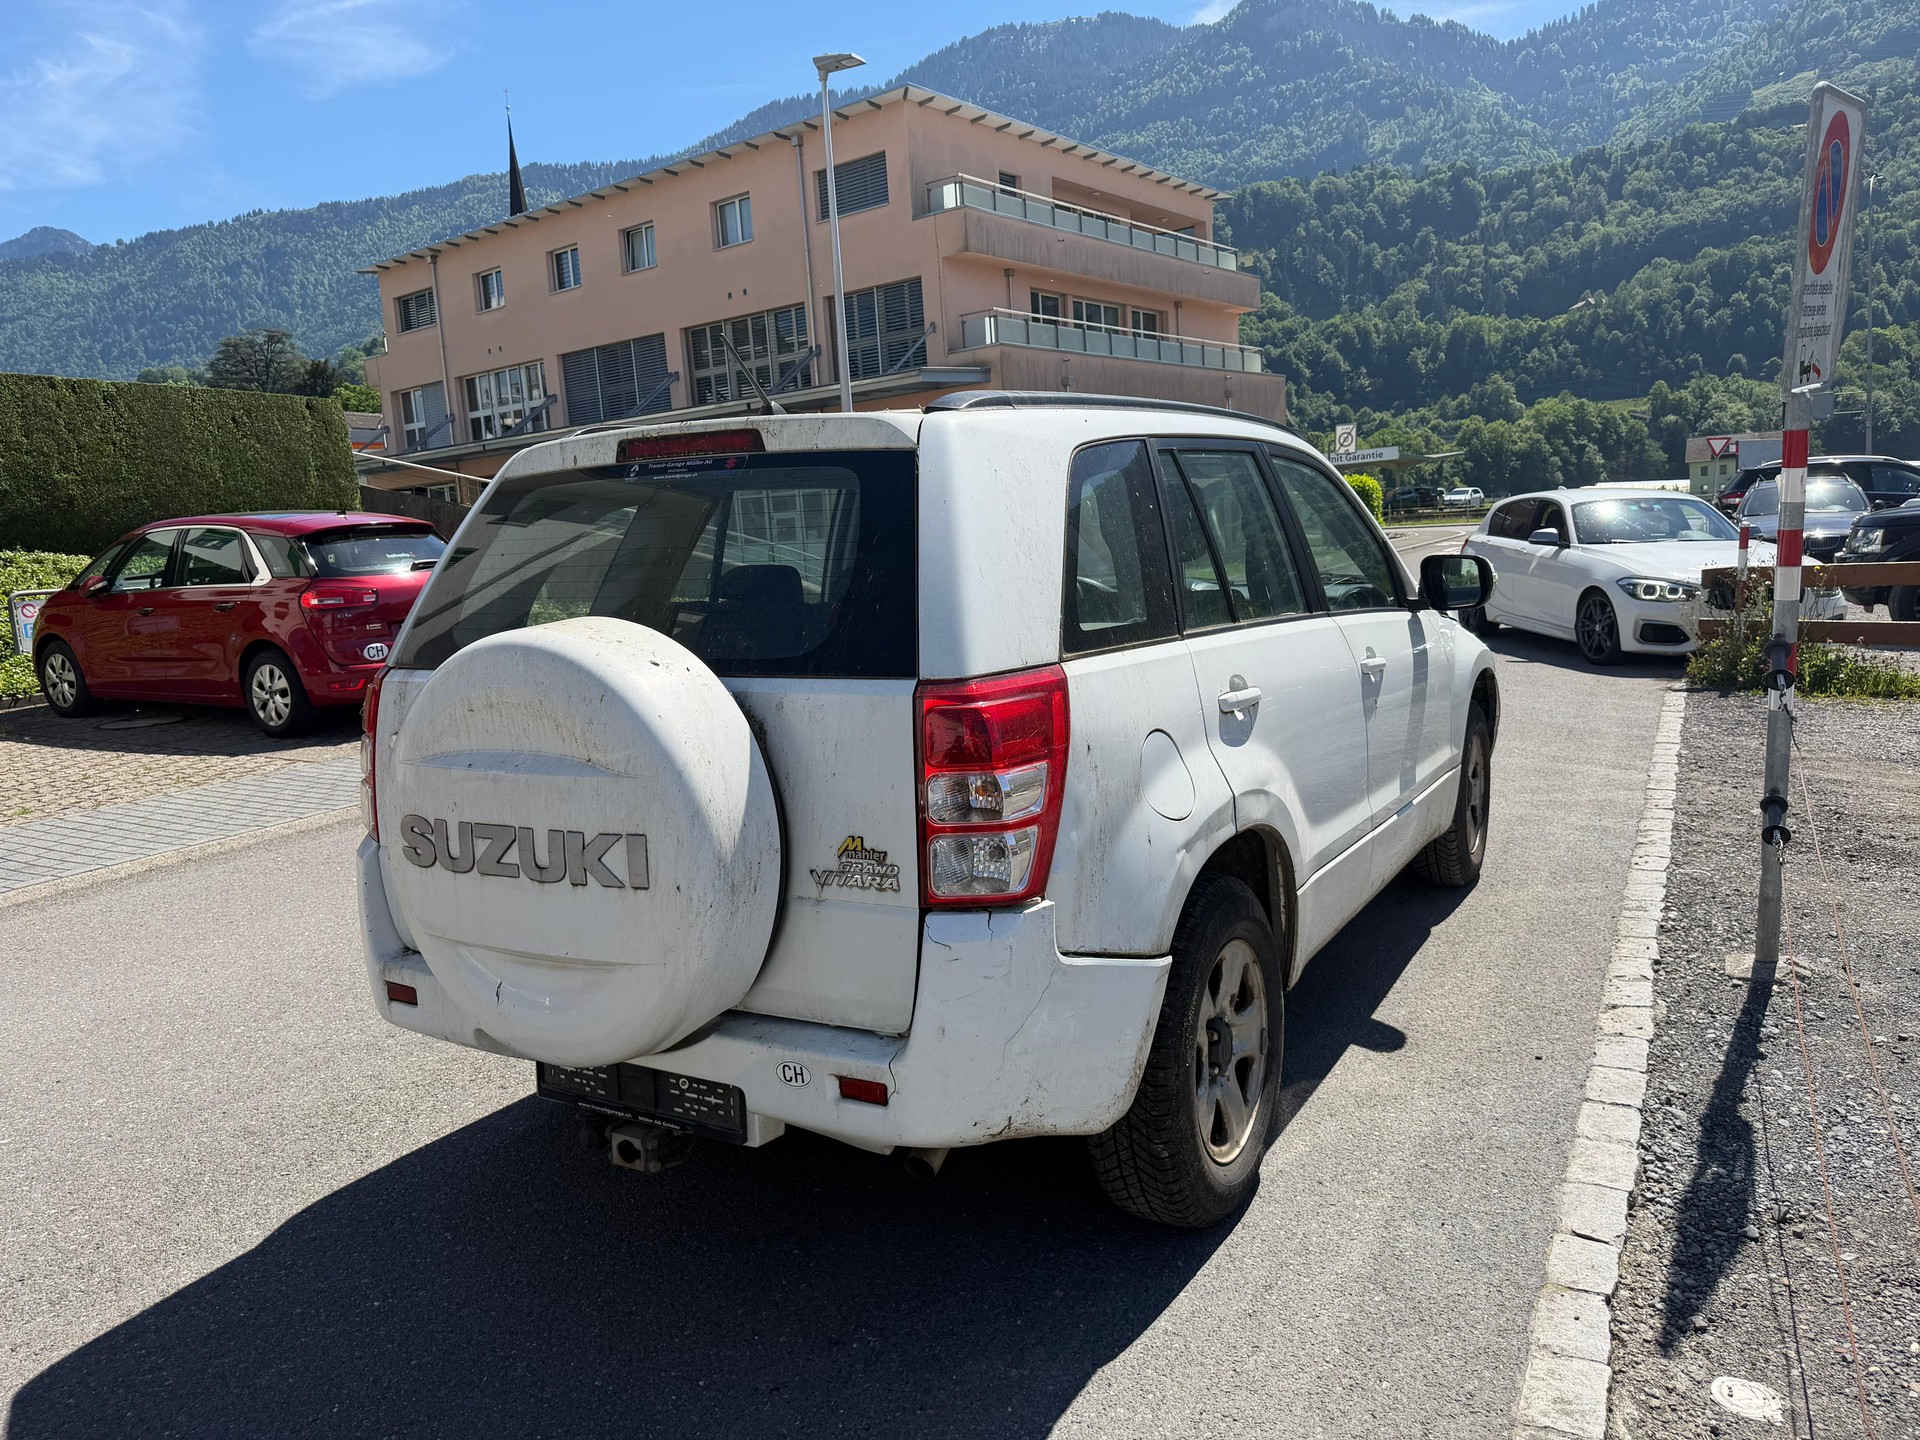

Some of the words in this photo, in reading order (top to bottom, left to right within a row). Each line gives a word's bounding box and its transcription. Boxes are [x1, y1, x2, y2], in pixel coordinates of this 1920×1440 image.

[1817, 300, 1827, 315] werden
[1345, 451, 1383, 461] Garantie
[648, 460, 685, 470] Transit-Garage
[685, 459, 704, 467] Müller
[367, 645, 385, 659] CH
[400, 814, 650, 890] SUZUKI
[845, 847, 887, 861] mahler
[838, 861, 900, 876] GRAND
[810, 868, 901, 893] VITARA
[781, 1064, 806, 1084] CH
[577, 1101, 633, 1118] www.transitgarage.ch
[638, 1115, 654, 1124] Müller
